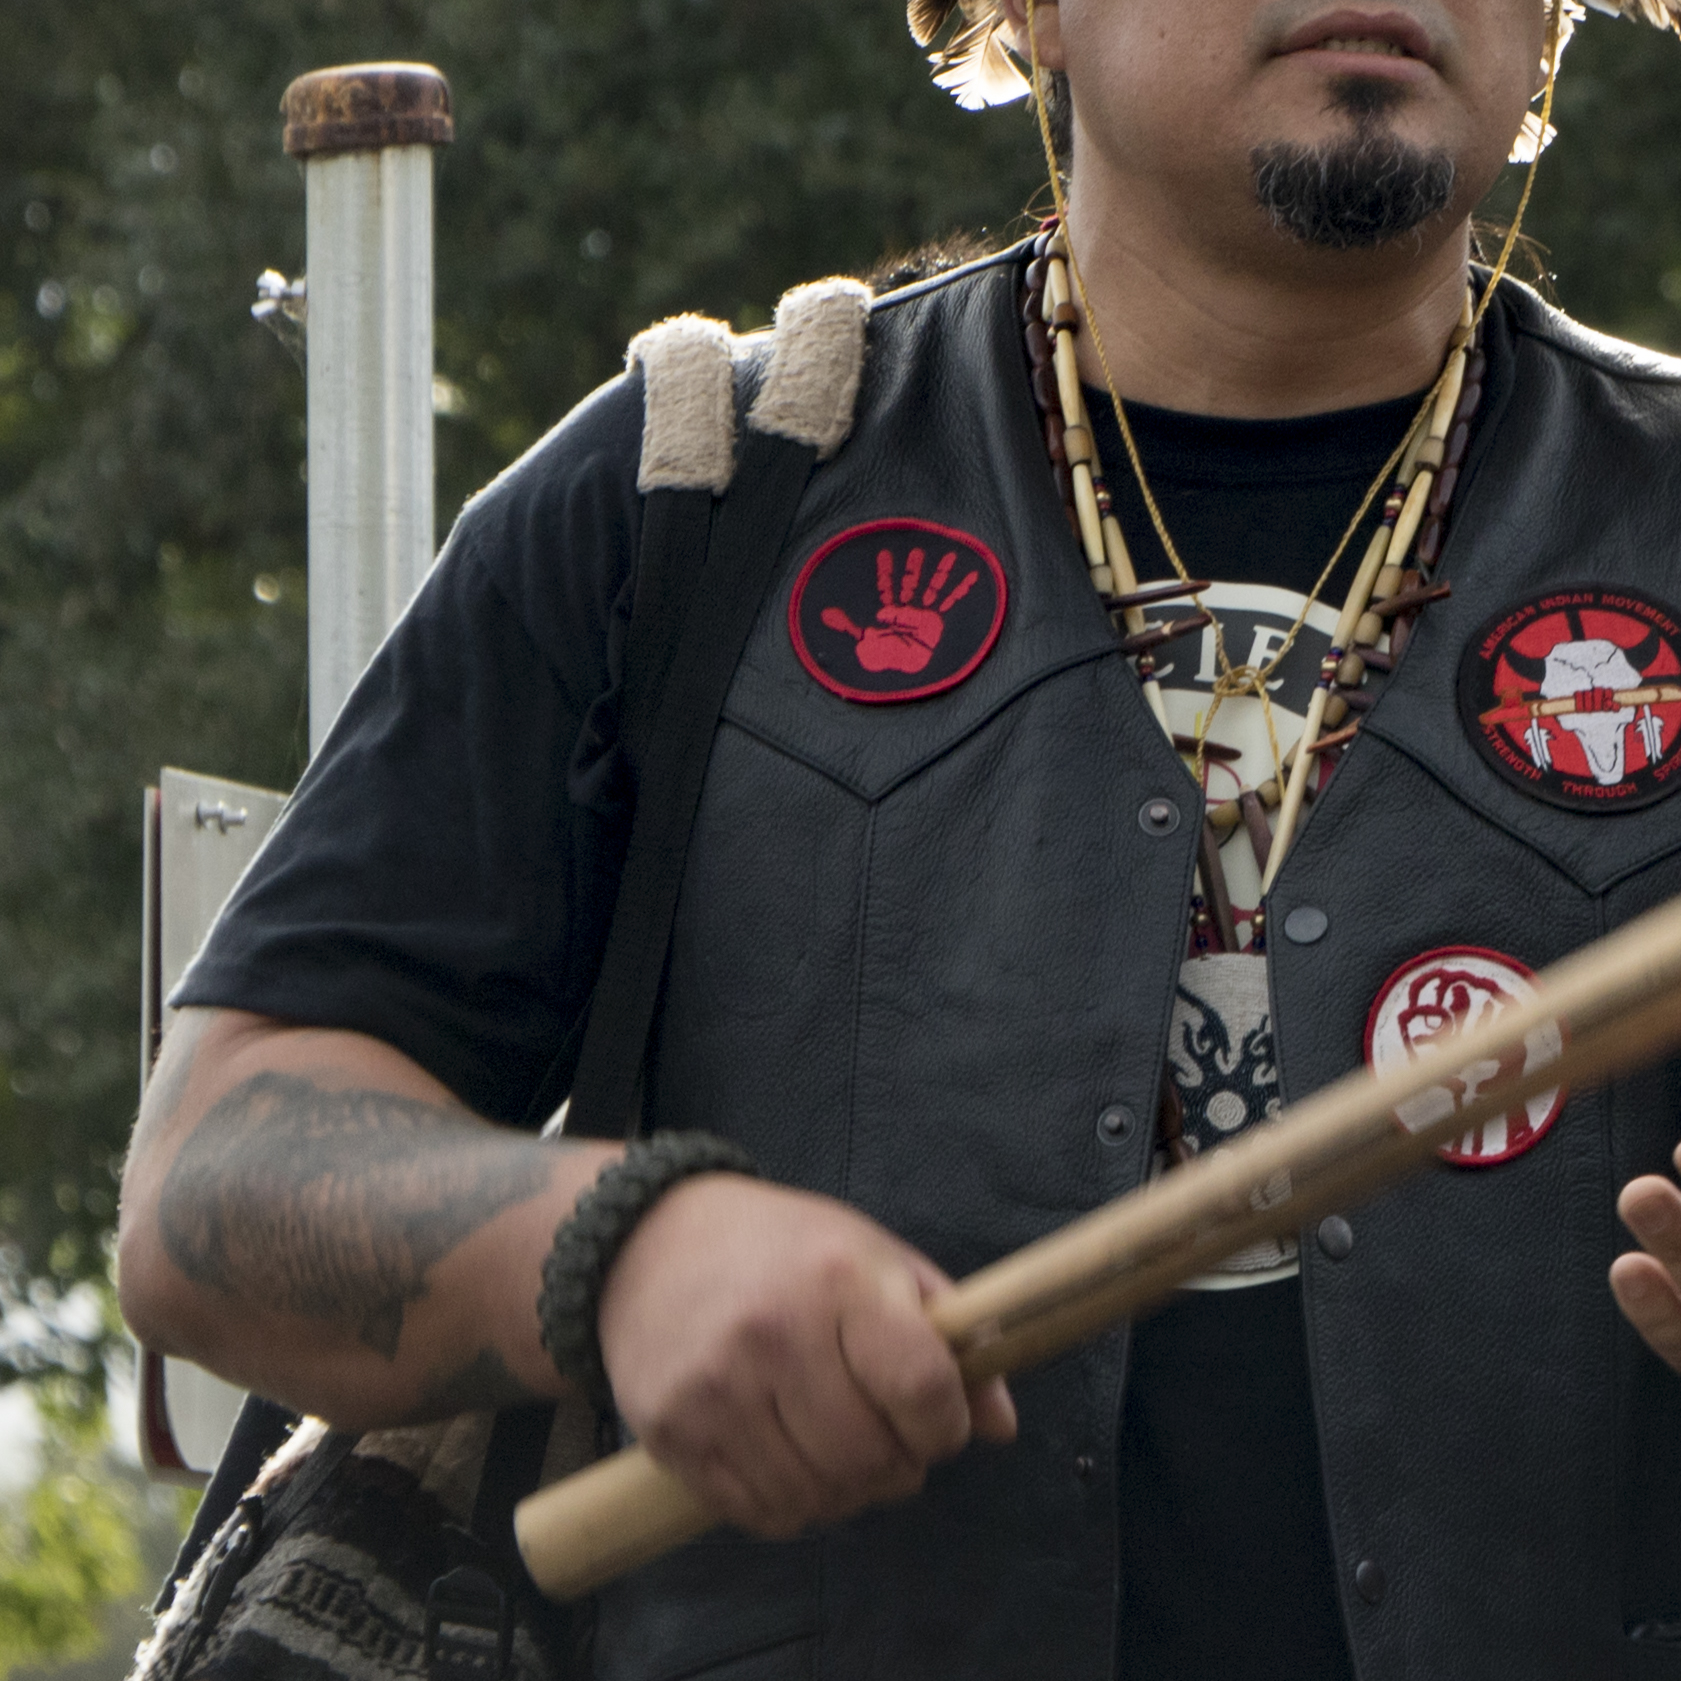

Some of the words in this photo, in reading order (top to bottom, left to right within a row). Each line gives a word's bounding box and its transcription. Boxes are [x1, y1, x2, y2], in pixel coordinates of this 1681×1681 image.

[1479, 604, 1537, 661] AMERICAN
[1539, 592, 1595, 609] INDIAN
[1601, 593, 1681, 637] MOVEMENT
